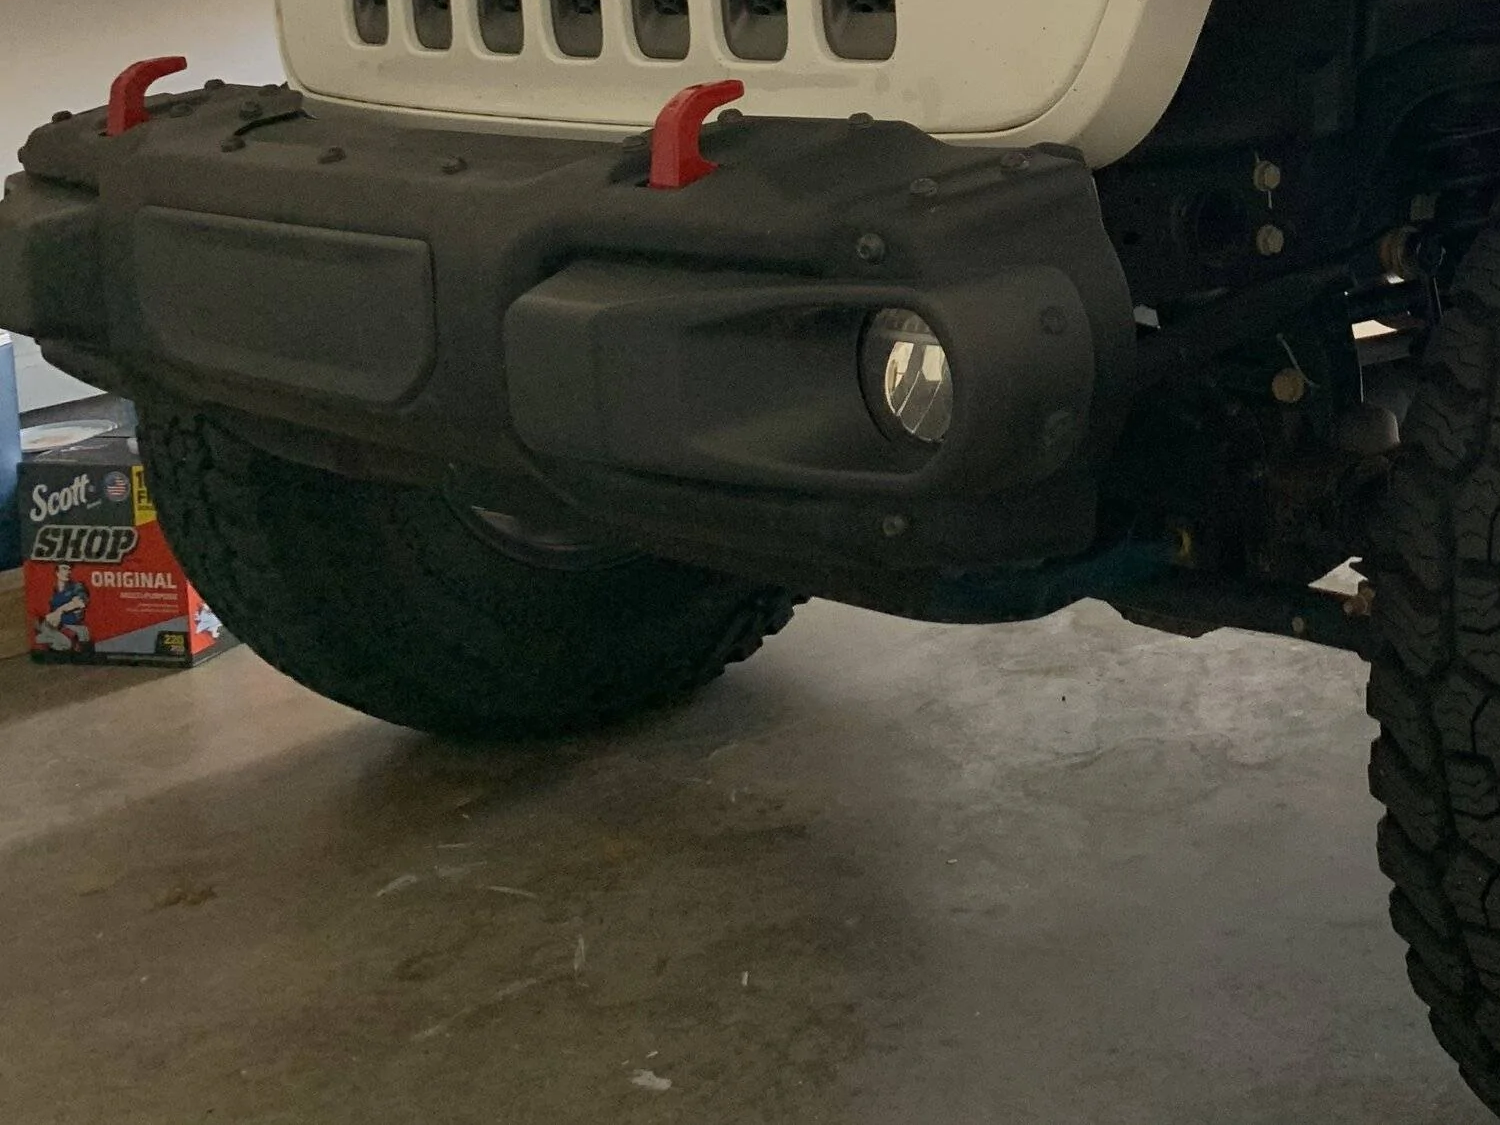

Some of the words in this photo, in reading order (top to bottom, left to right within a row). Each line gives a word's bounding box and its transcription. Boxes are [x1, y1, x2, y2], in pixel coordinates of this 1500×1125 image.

[29, 474, 90, 522] Scott
[33, 527, 136, 561] SHOP
[91, 571, 177, 589] ORIGINAL
